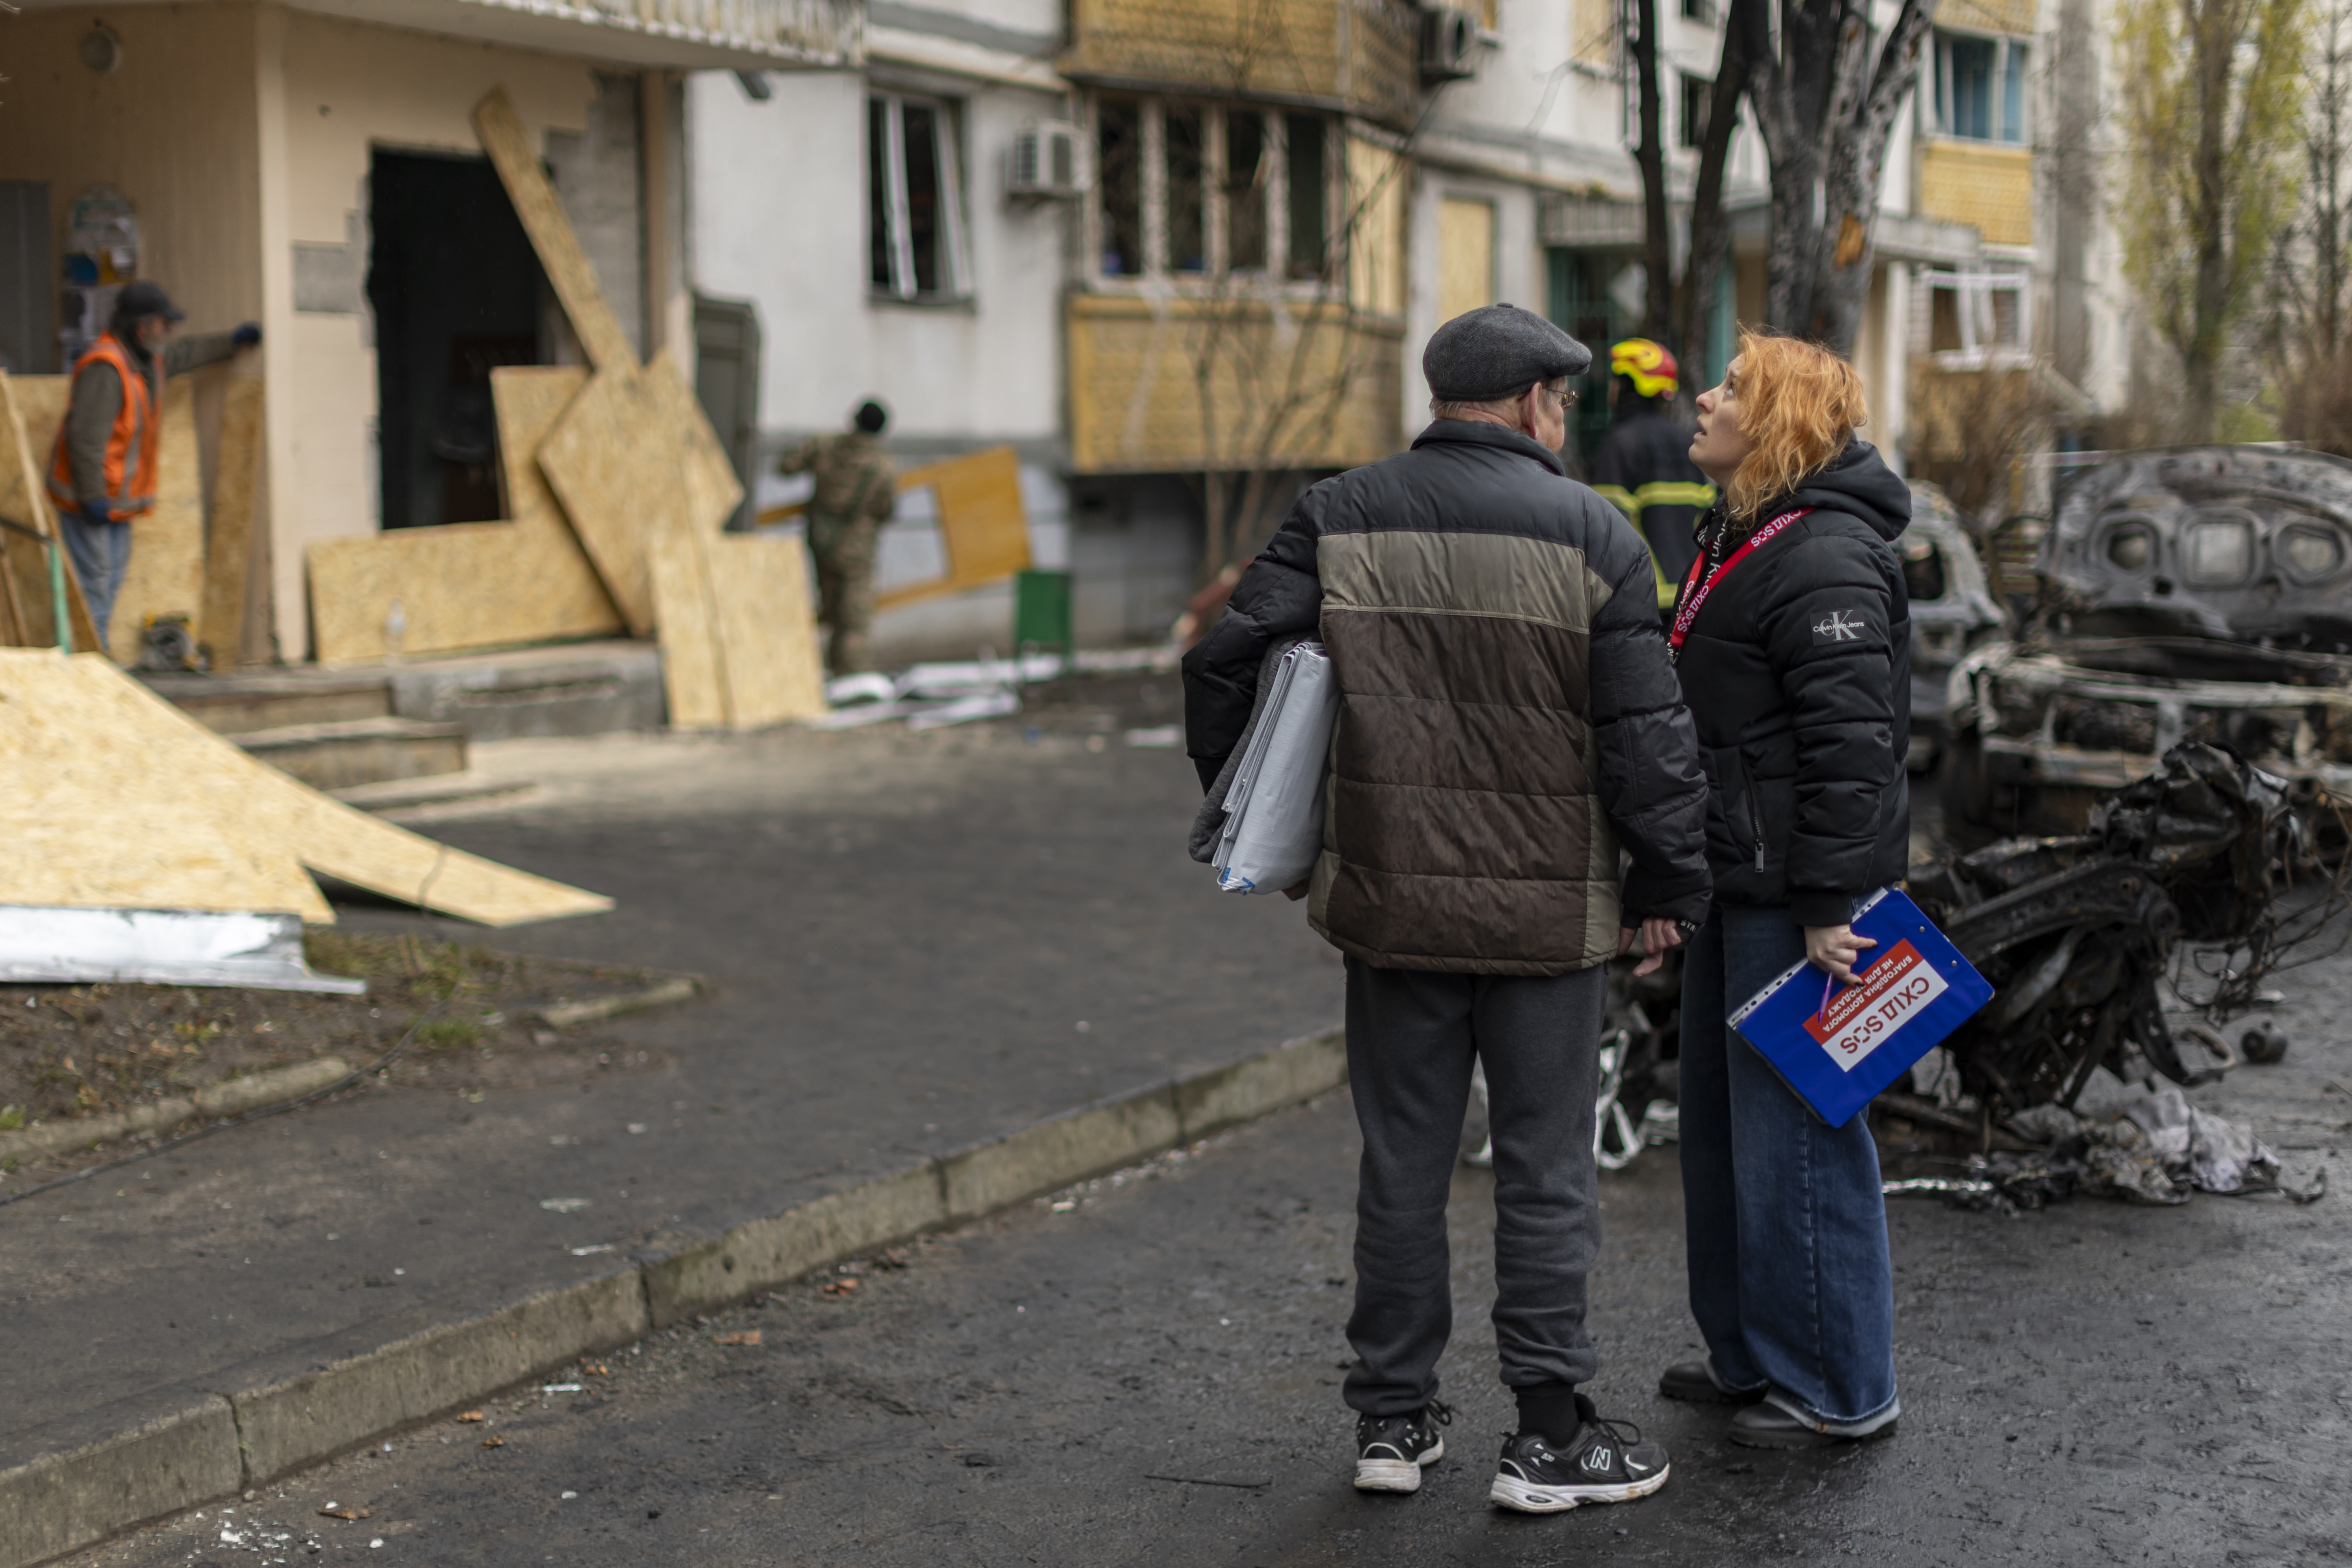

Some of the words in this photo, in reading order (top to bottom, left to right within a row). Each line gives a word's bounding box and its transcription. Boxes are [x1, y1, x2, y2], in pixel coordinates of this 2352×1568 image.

[1751, 525, 1774, 547] SOS
[1689, 585, 1709, 612] СХІД
[1677, 609, 1694, 632] SOS
[1863, 955, 1913, 997] БЛАГОДІЙНА
[1864, 966, 1882, 984] ДЛЯ
[1880, 958, 1894, 971] НЕ
[1878, 977, 1930, 1021] СХІД
[1822, 993, 1865, 1032] ДОПОМОГА
[1840, 1015, 1884, 1054] SOS
[1589, 1445, 1611, 1471] N
